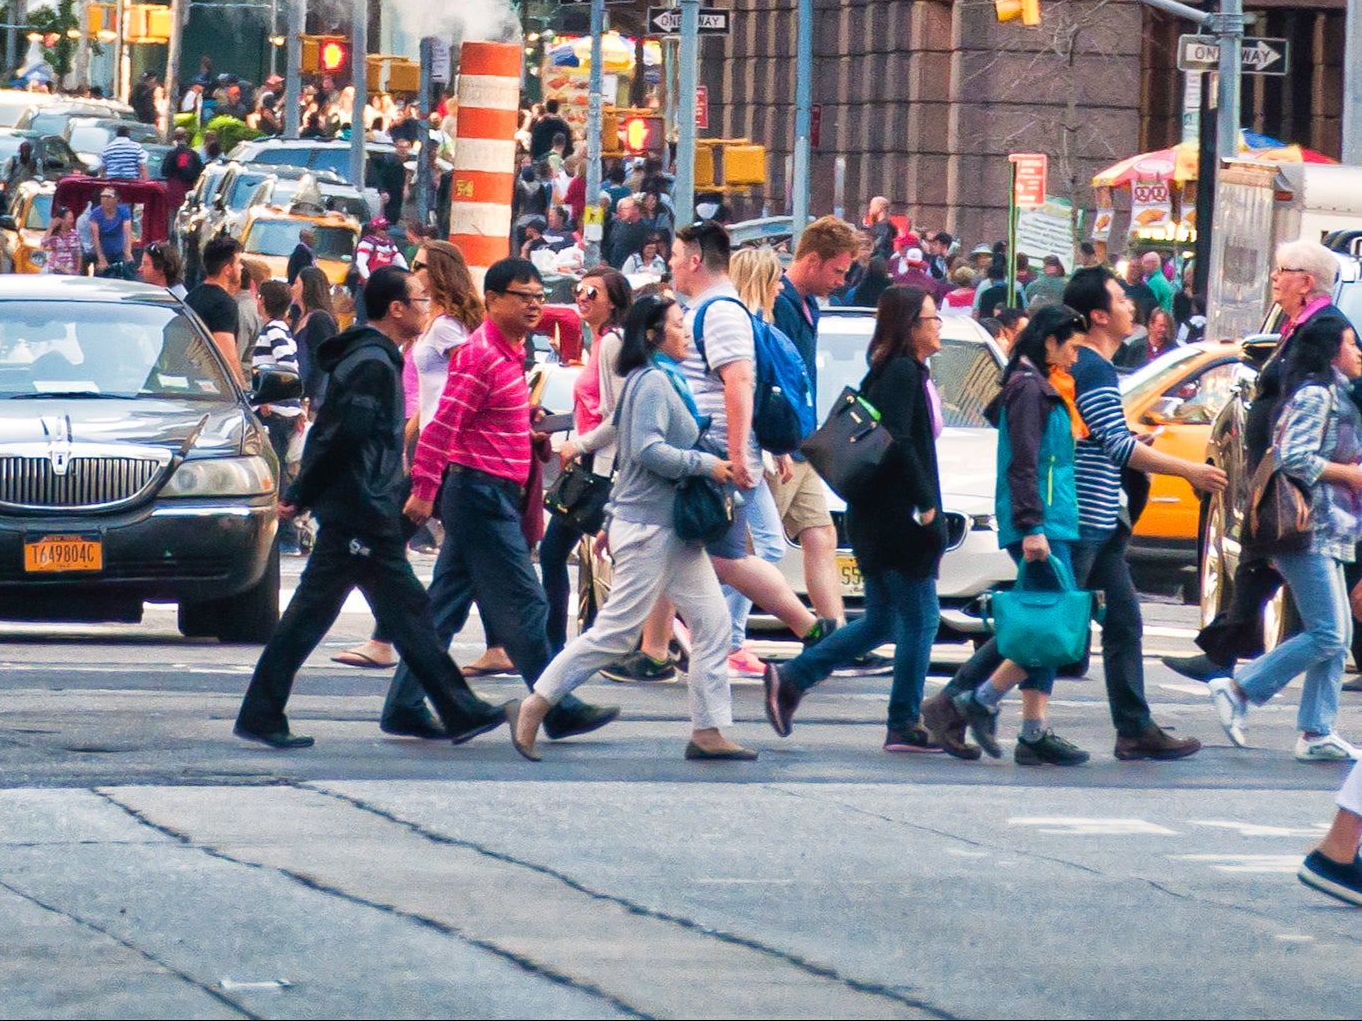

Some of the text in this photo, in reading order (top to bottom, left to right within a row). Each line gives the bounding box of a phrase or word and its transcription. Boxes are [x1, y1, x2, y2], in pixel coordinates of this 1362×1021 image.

[660, 15, 682, 25] ONE
[1195, 47, 1219, 60] ON
[31, 544, 95, 564] T649804C
